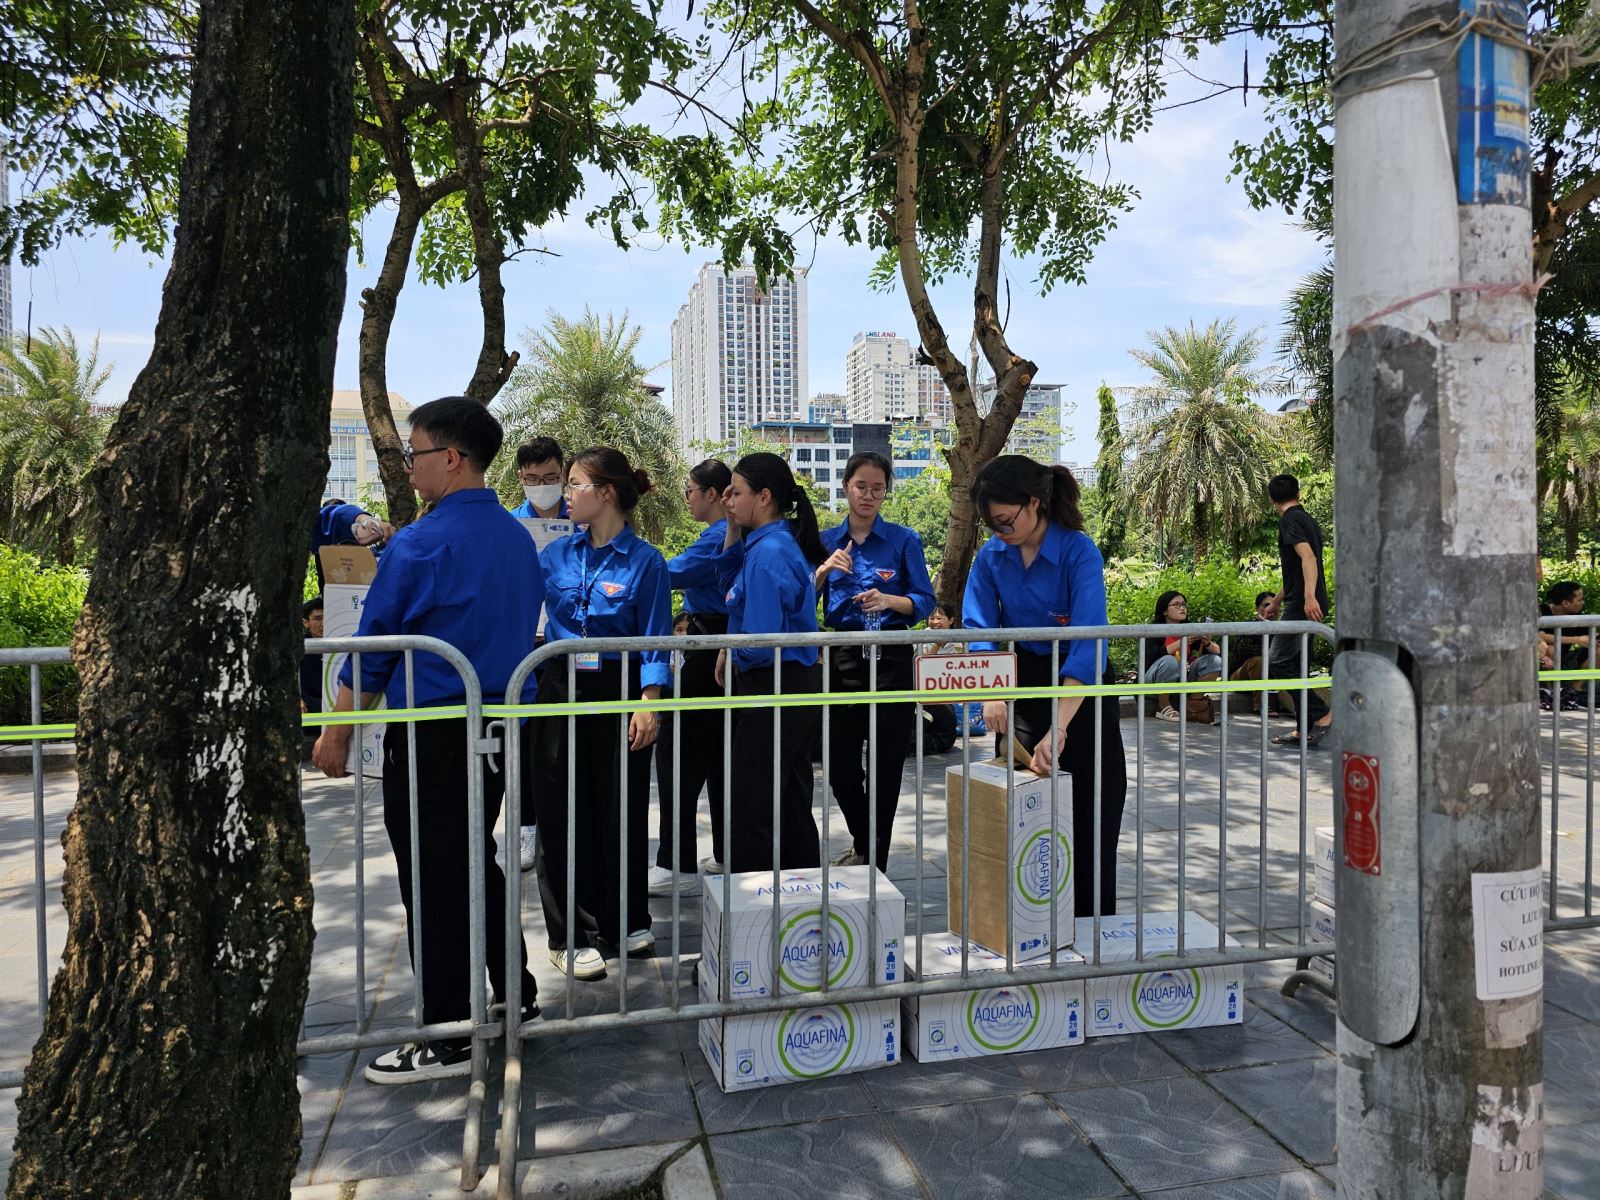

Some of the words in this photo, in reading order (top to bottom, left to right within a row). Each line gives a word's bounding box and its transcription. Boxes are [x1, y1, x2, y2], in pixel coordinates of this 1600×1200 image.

[946, 660, 989, 670] C.A.H.N
[925, 673, 976, 690] DỪNG
[1038, 837, 1050, 898] AQUAFINA
[1500, 886, 1526, 902] CỨU
[1101, 927, 1177, 940] AQUFINA
[781, 940, 848, 964] AQUAFNA
[1500, 936, 1525, 953] SỬA
[886, 962, 896, 970] 28
[1138, 984, 1195, 1004] AQUAFINA
[973, 1001, 1033, 1024] AQUAFINA
[1228, 1002, 1237, 1010] 28
[1068, 1021, 1078, 1029] 28
[784, 1025, 848, 1053] AQUAFINA
[885, 1043, 895, 1051] 28
